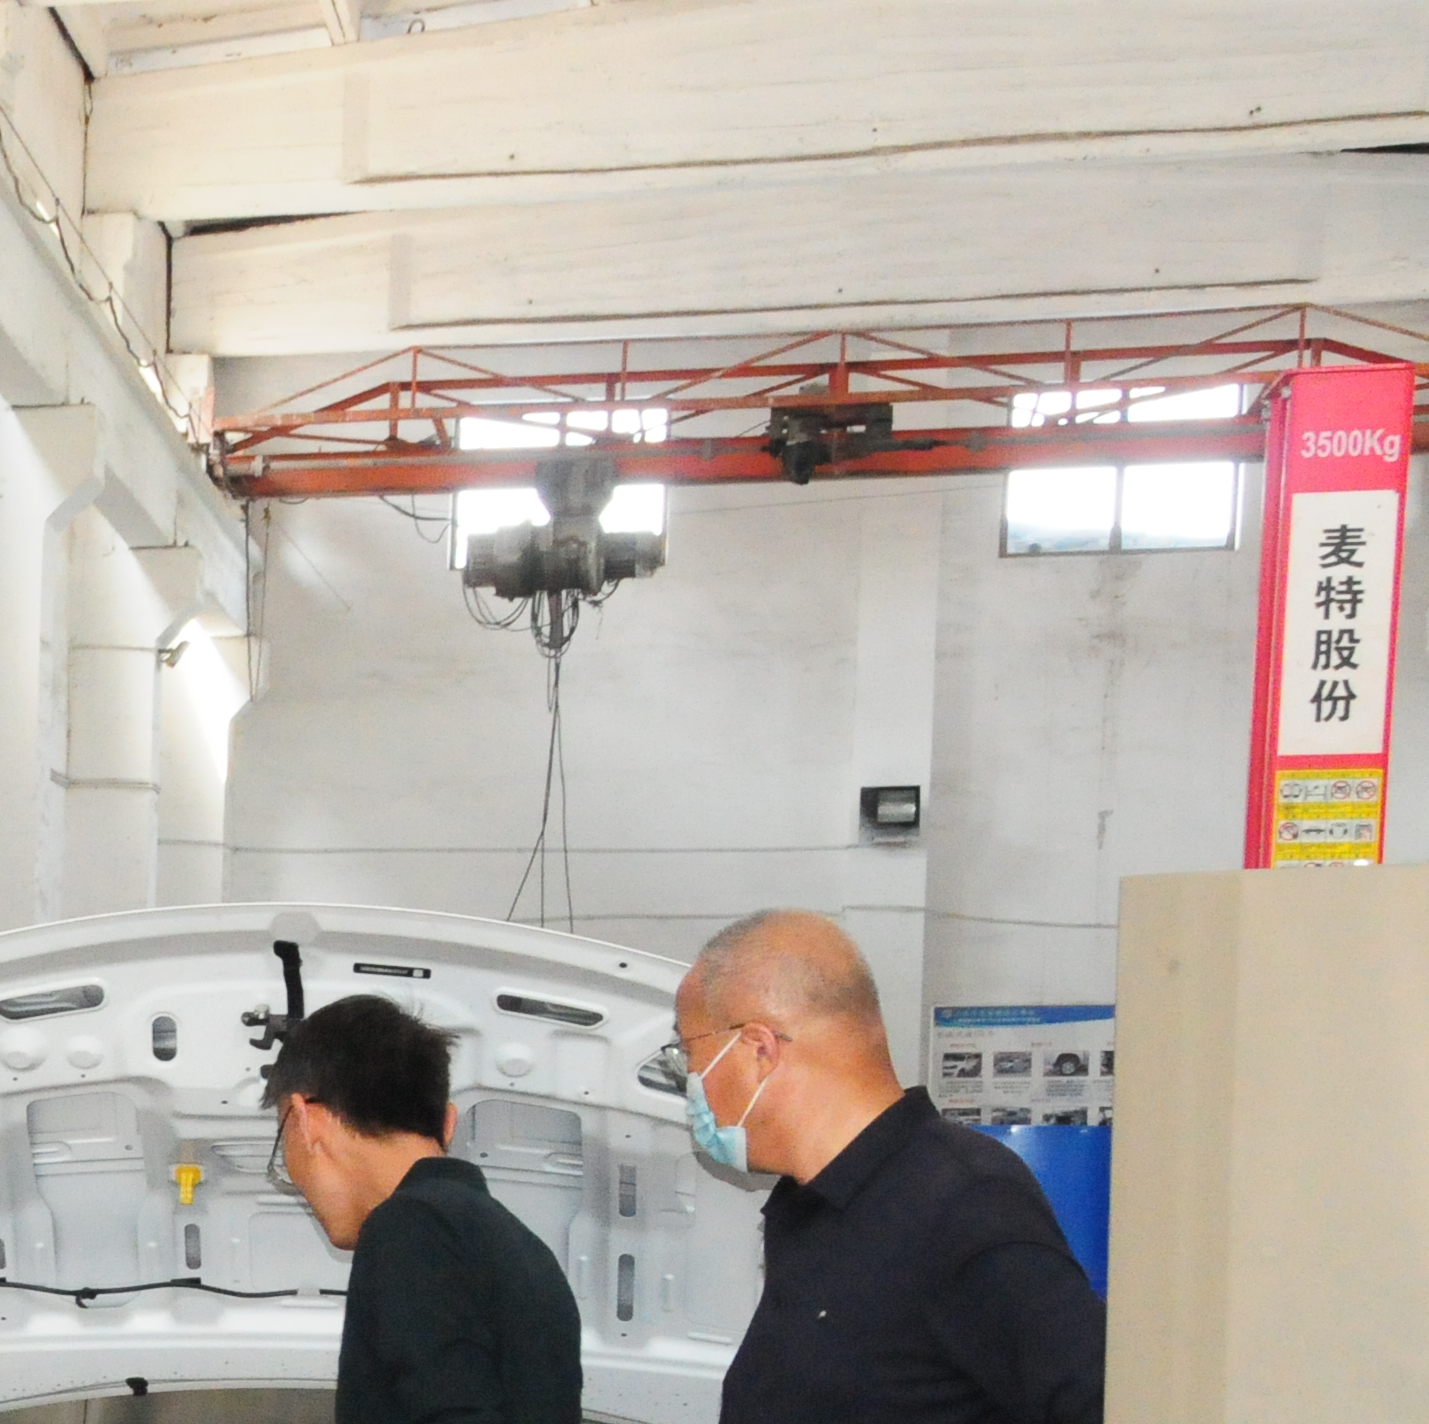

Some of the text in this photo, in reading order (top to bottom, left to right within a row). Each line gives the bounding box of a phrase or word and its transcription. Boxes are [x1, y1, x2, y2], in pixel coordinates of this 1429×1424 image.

[1299, 428, 1402, 462] 3500Kg
[1309, 524, 1367, 723] 麦特股份
